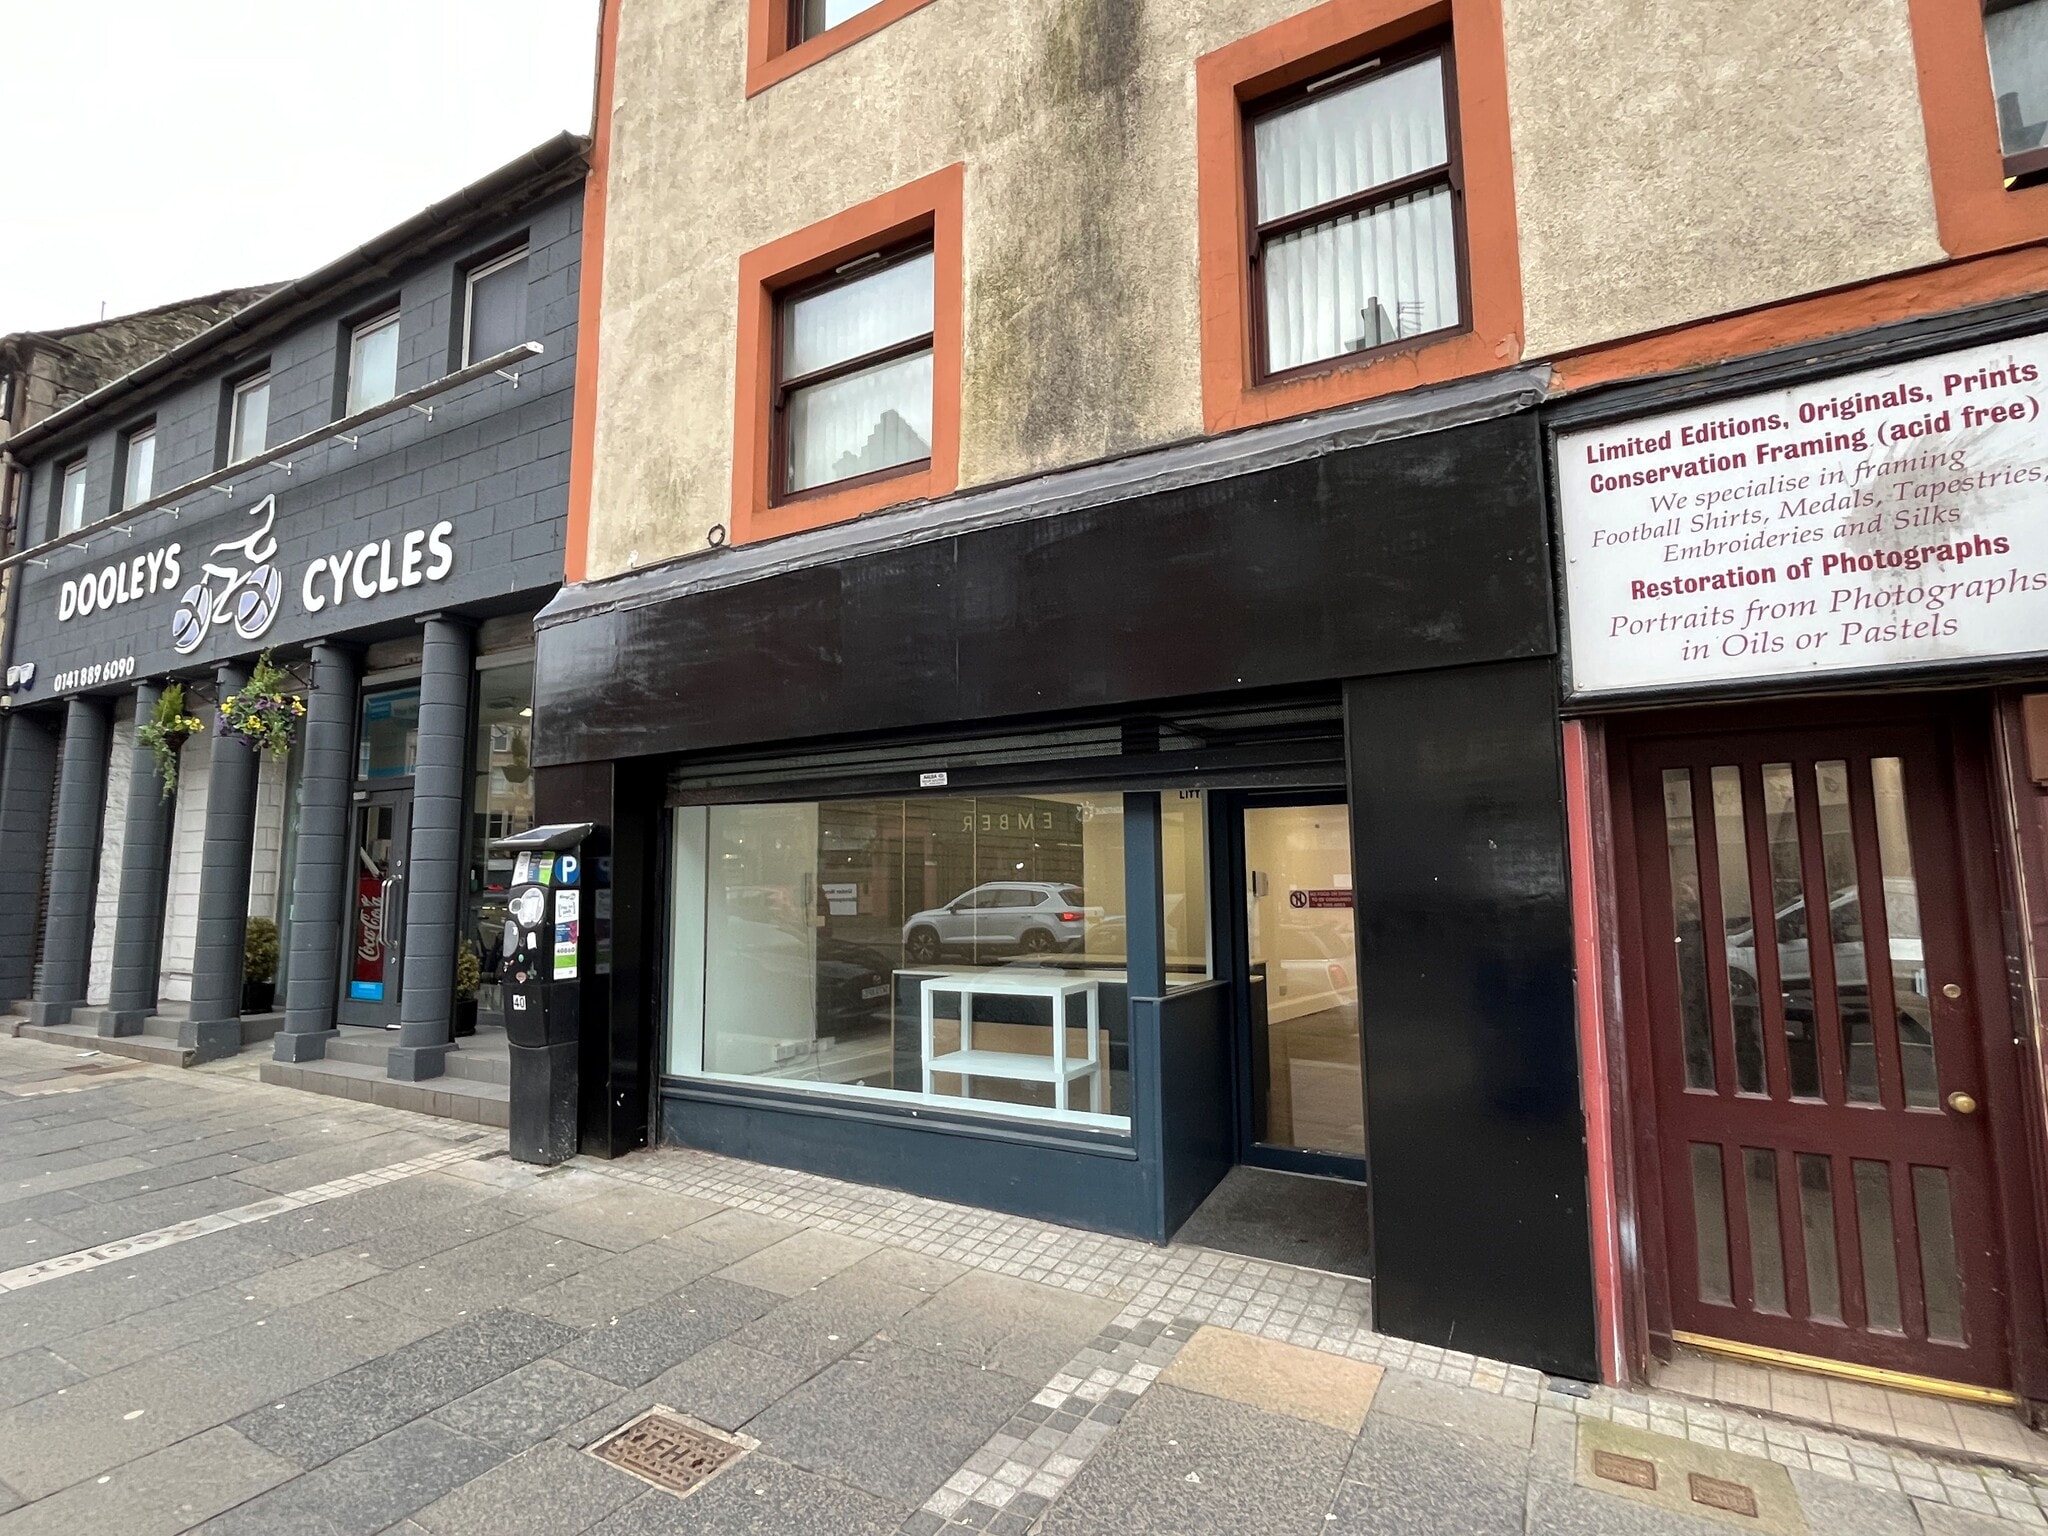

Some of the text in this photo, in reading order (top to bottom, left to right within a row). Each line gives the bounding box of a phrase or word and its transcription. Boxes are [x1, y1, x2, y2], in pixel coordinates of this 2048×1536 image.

[1586, 362, 2038, 464] Limited Editions, Originals, Prints
[1590, 395, 2040, 493] Conservation Framing (acid free)
[1592, 464, 2048, 548] Football Shirts, Medals, Tapestries,
[1650, 446, 1967, 514] We specialise in framing
[1664, 505, 1961, 562] Embroideries and Silks
[58, 520, 454, 622] DOOLEYS CYCLES
[1631, 533, 2010, 600] Restoration of Photographs
[1609, 568, 2048, 637] Portraits from Photographs
[1682, 614, 1959, 661] in Oils or Pastels
[53, 656, 135, 693] 0141 889 6090
[1179, 789, 1200, 799] LITT
[562, 856, 577, 882] P
[514, 996, 525, 1009] 40
[645, 1438, 691, 1463] FH
